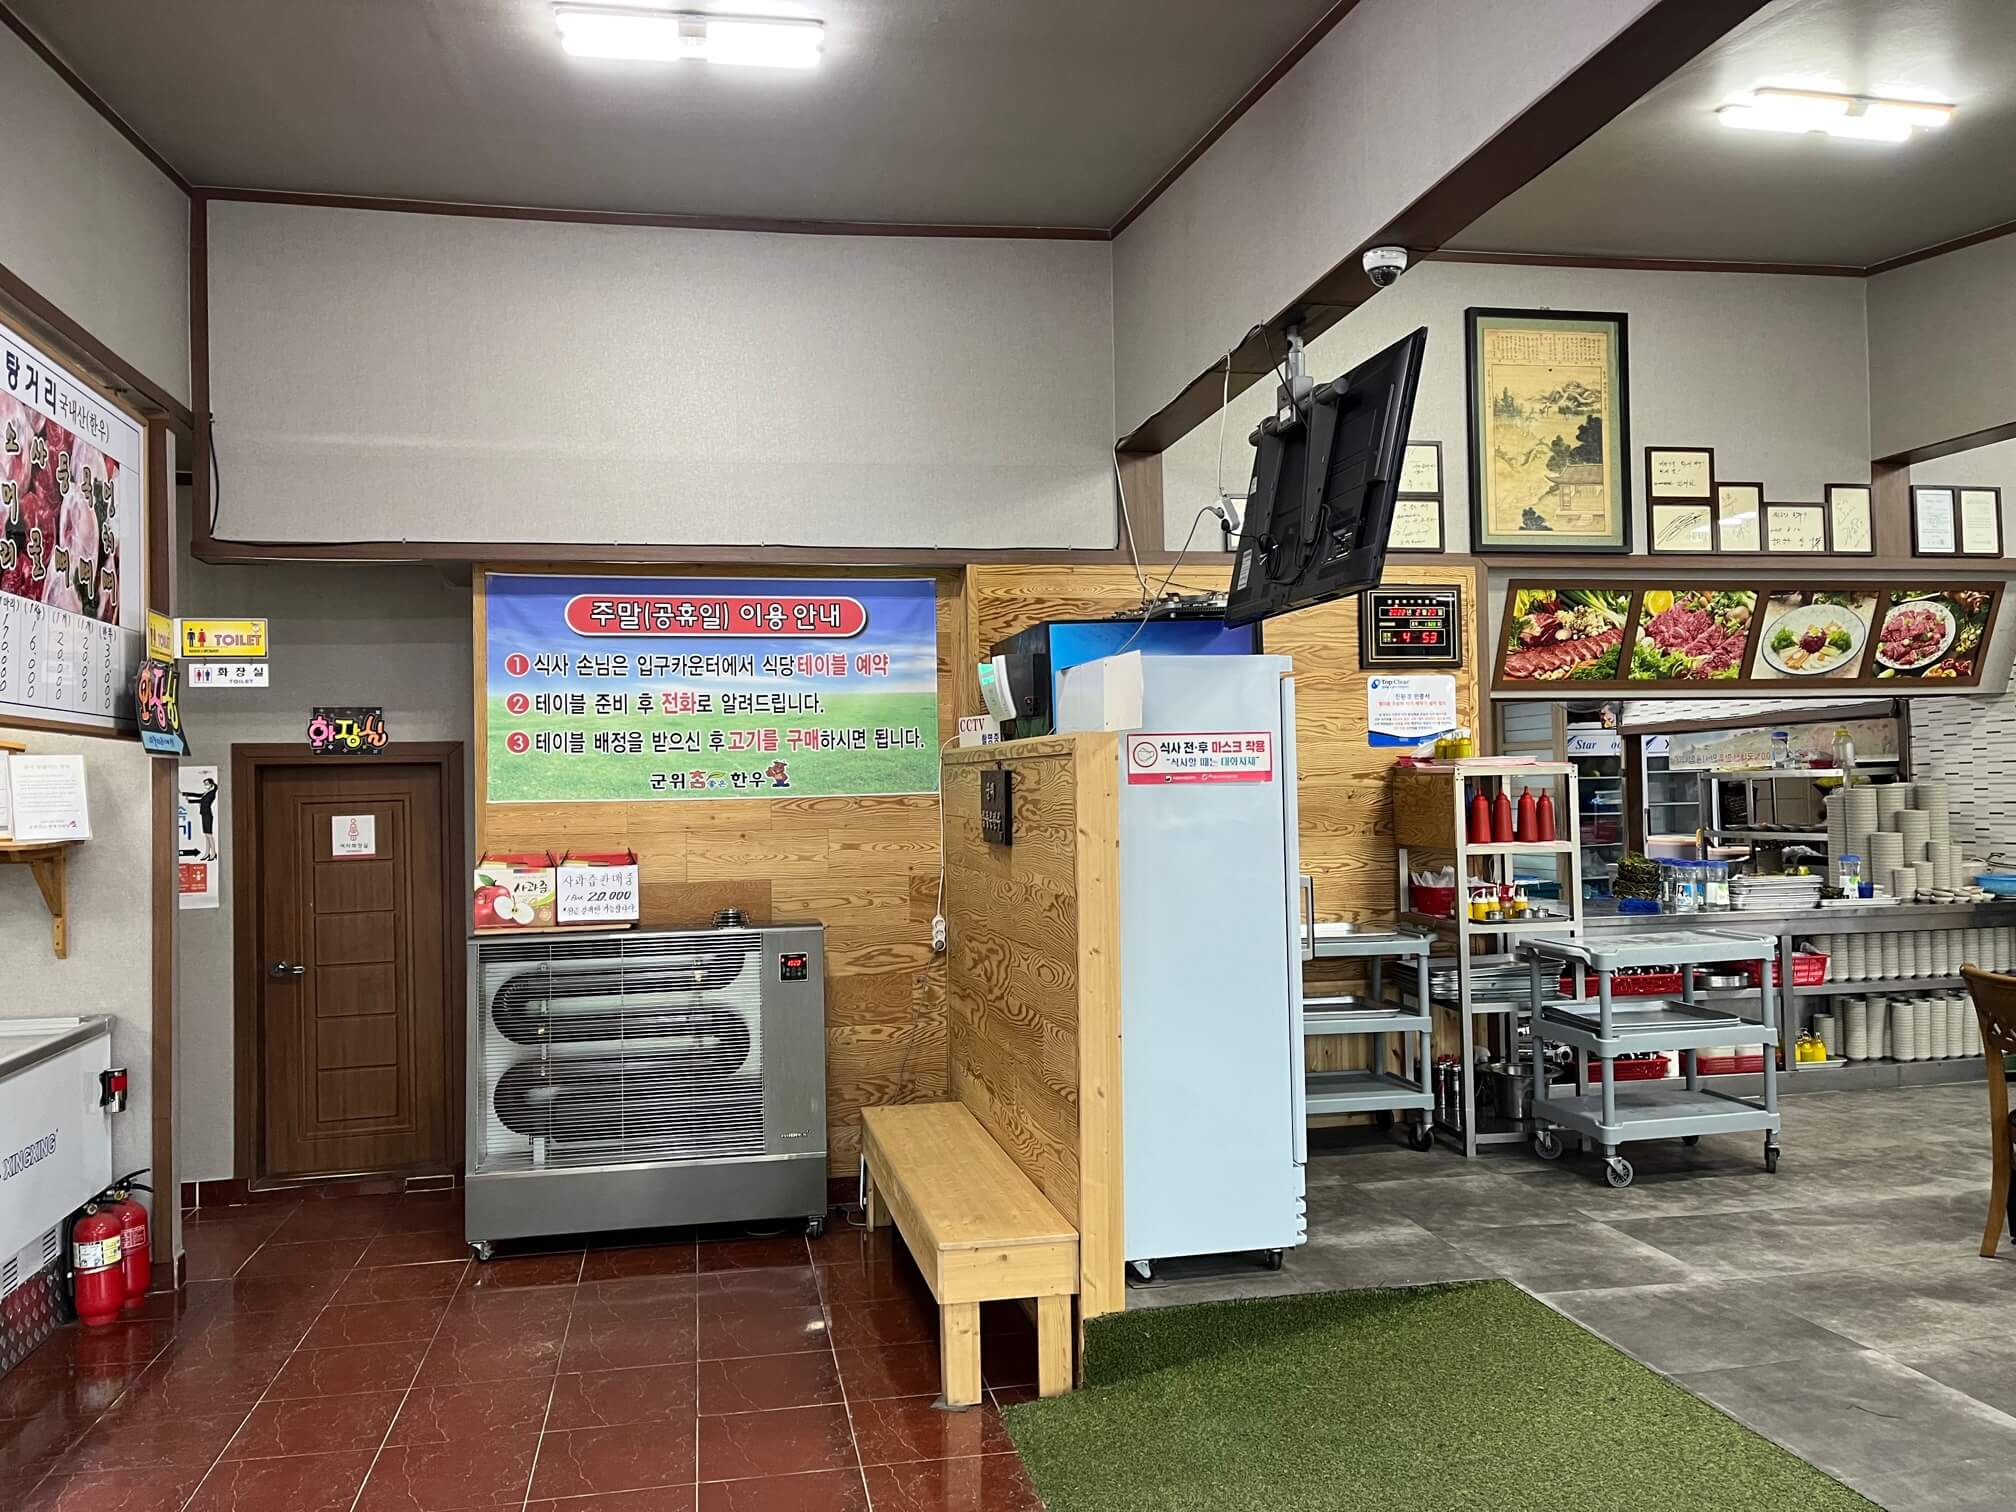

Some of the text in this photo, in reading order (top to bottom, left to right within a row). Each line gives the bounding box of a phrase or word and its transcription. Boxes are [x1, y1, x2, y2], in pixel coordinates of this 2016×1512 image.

[590, 601, 841, 631] 주말(공휴일) 이용 안내
[214, 634, 262, 646] TOILET
[217, 667, 264, 678] 화장실
[534, 655, 569, 677] 식사
[576, 654, 629, 677] 손님은
[637, 654, 754, 677] 입구카운터에서
[855, 653, 889, 675] 예약
[535, 693, 586, 715] 테이블
[595, 694, 629, 715] 준비
[637, 693, 655, 715] 후
[661, 691, 713, 715] 전화로
[721, 692, 825, 714] 알려드립니다.
[308, 714, 388, 748] 화장실
[960, 718, 985, 732] CCTV
[535, 732, 586, 754] 테이블
[594, 732, 644, 754] 배정을
[652, 731, 701, 752] 받으신
[787, 729, 866, 751] 구매하시면
[874, 727, 925, 749] 됩니다.
[1160, 740, 1265, 754] 식사 전·후 마스크 착용
[1576, 740, 1597, 750] Star
[650, 773, 686, 790] 군위
[730, 772, 766, 788] 한우
[514, 880, 548, 893] 사과즙
[587, 891, 632, 902] 20.000
[3, 1133, 56, 1181] XINGXING
